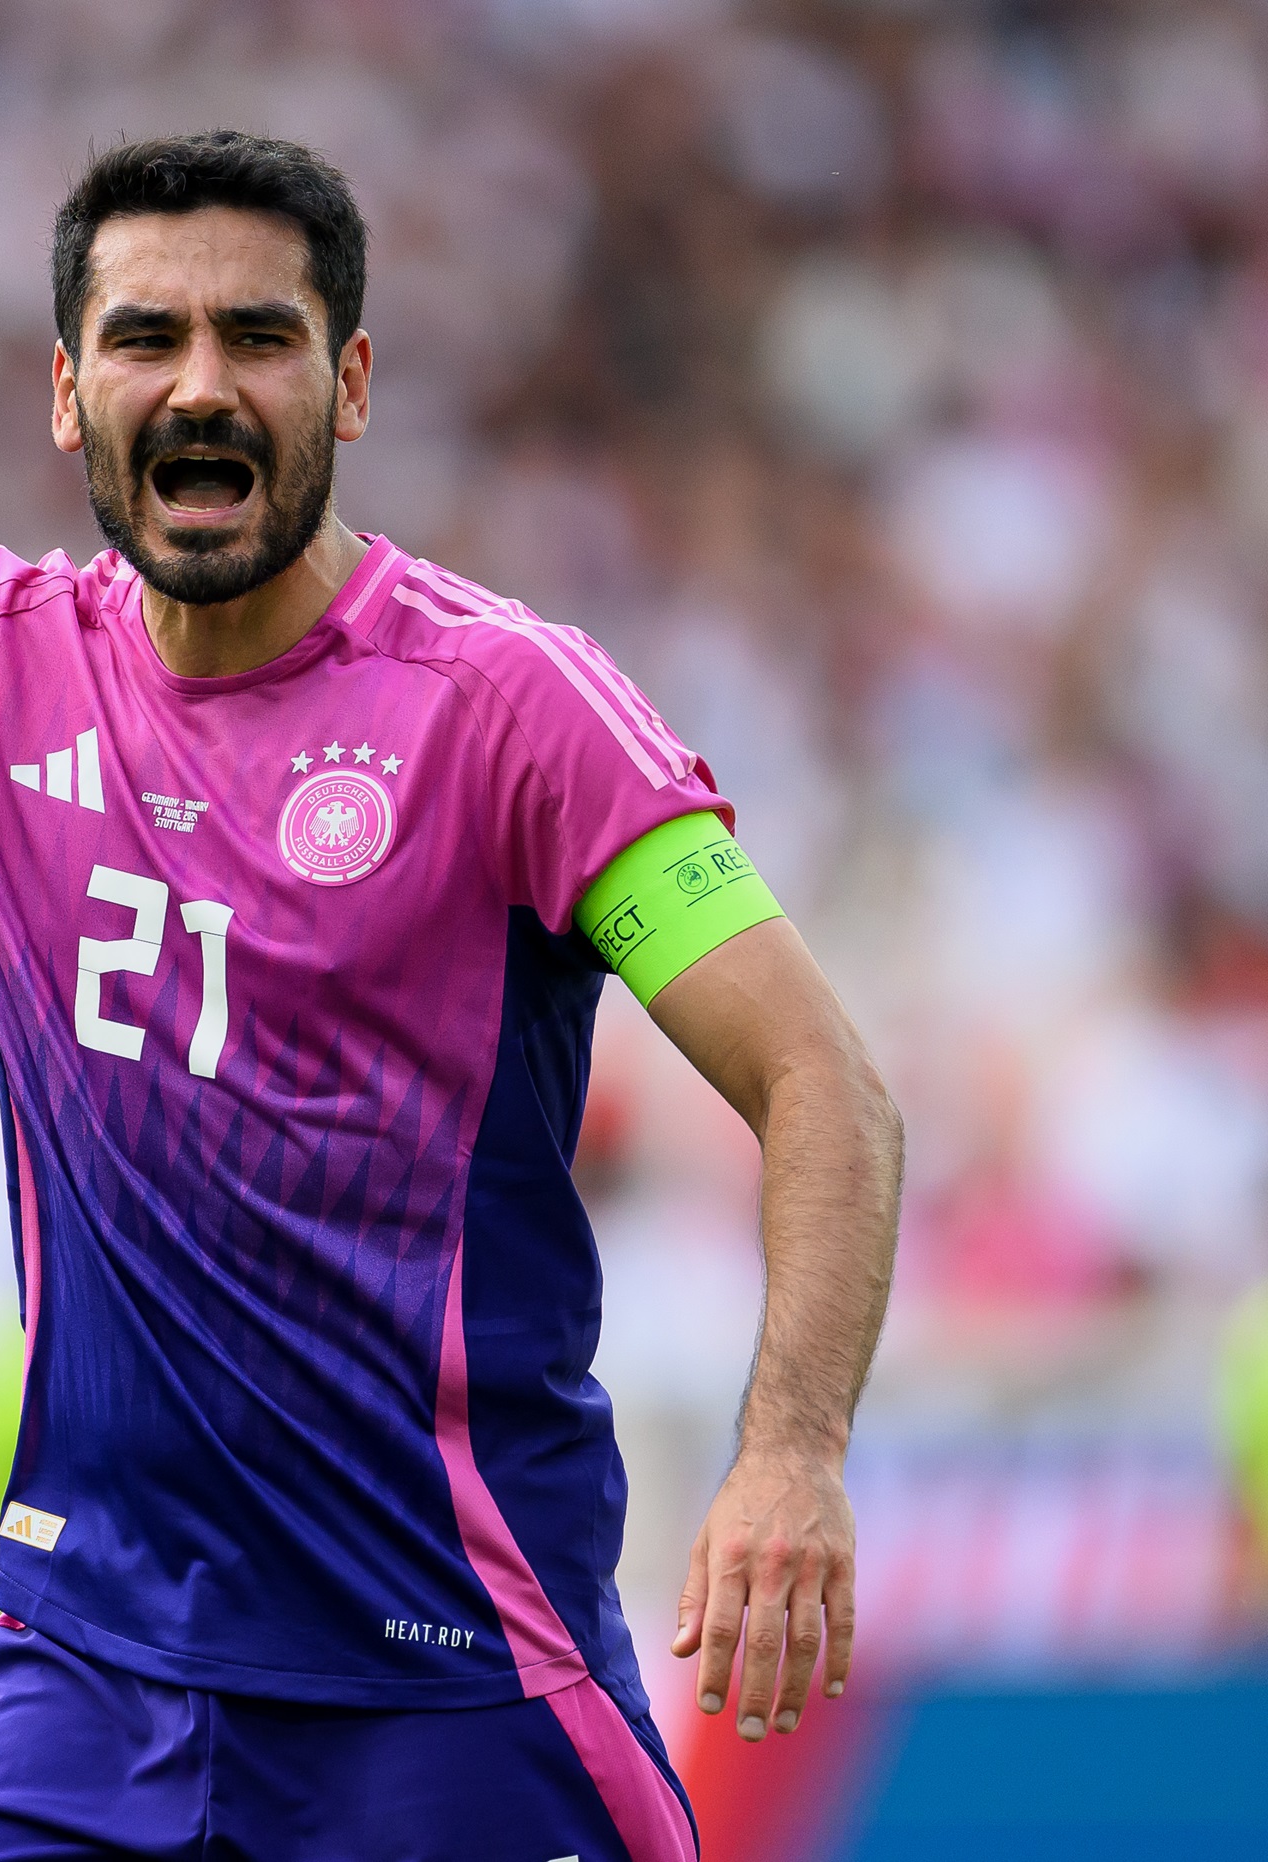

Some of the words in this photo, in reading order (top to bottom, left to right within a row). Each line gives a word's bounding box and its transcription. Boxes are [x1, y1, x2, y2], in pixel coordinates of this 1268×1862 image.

[141, 792, 179, 808] GERMANY
[307, 784, 370, 804] DEUTSCHER
[153, 805, 163, 816] 19
[163, 807, 183, 820] JUNE
[154, 817, 195, 833] STUTTGART
[294, 836, 372, 867] FUSSBALL-BUND
[679, 865, 696, 877] UEFA
[74, 864, 234, 1079] 21
[384, 1619, 474, 1649] HEAT.RDY
